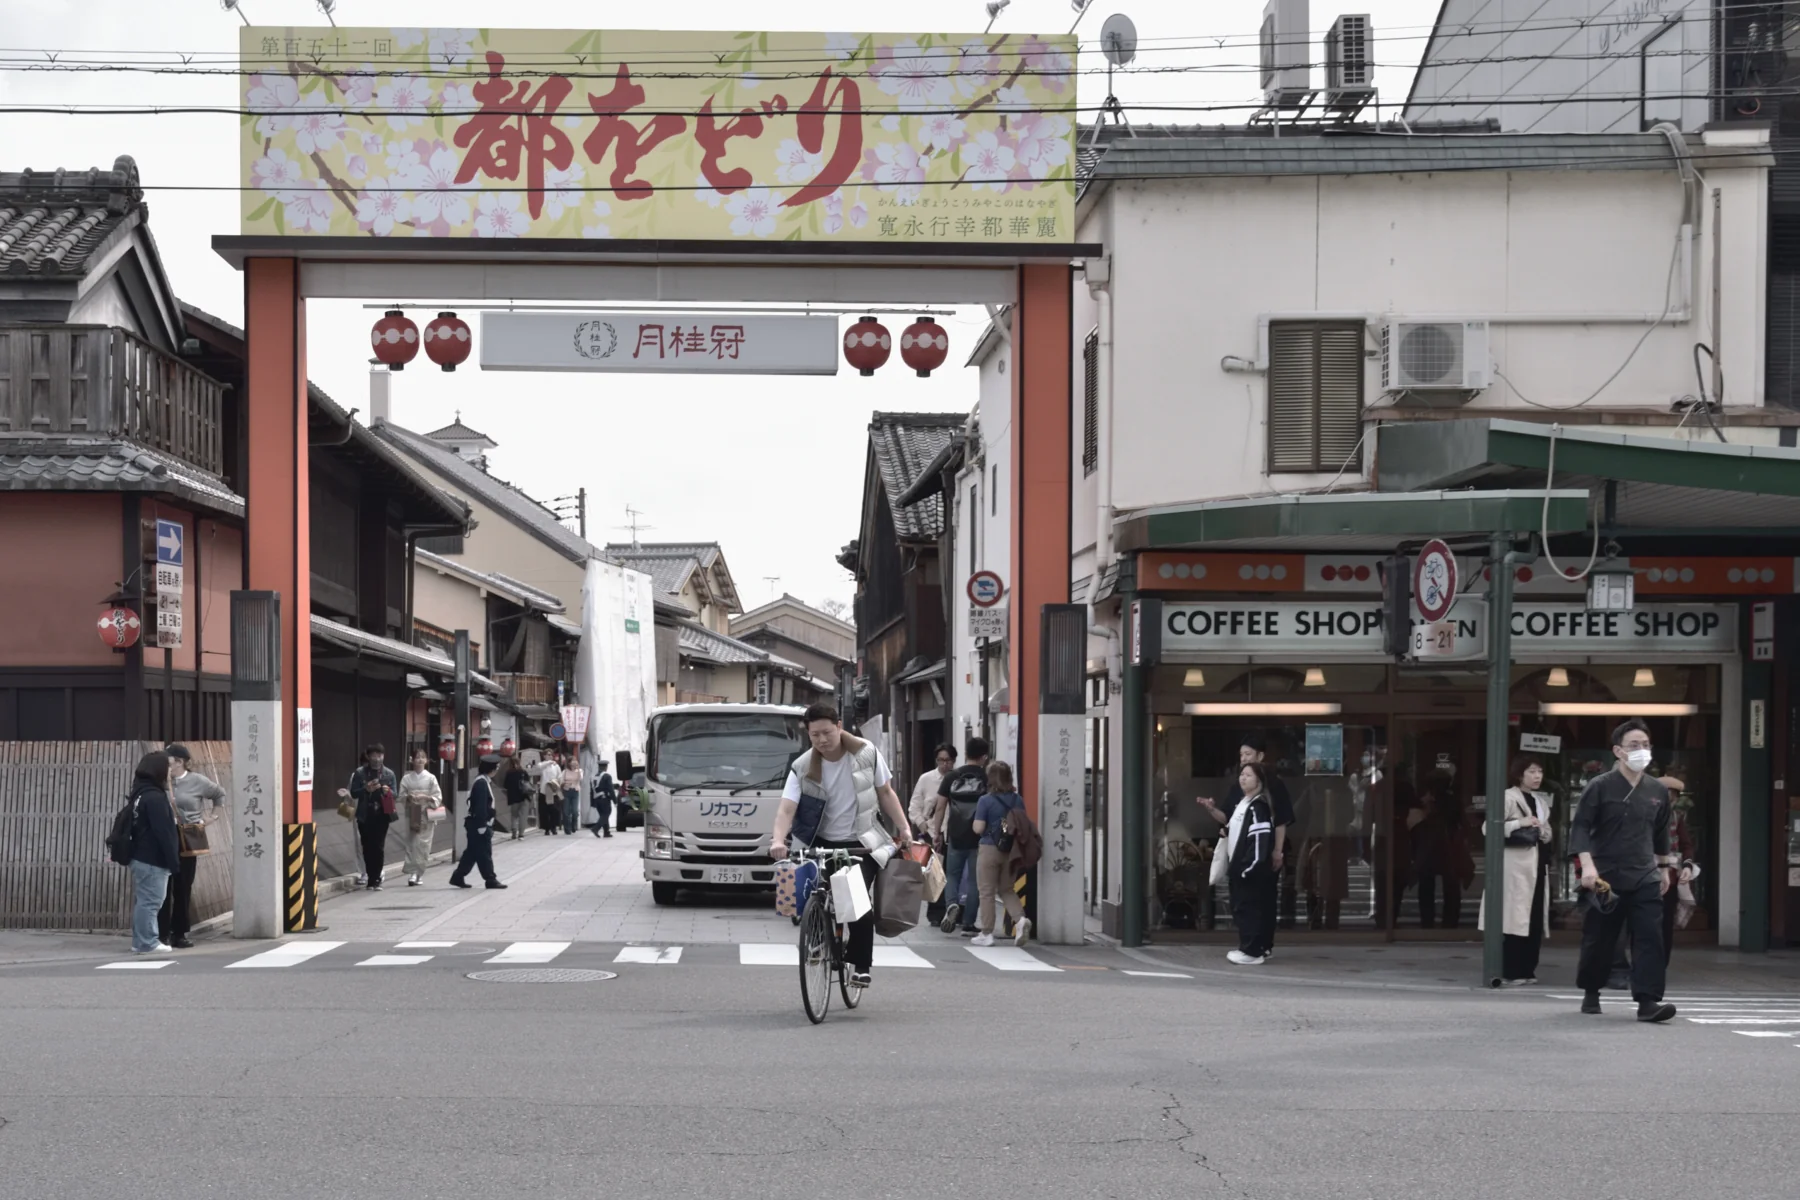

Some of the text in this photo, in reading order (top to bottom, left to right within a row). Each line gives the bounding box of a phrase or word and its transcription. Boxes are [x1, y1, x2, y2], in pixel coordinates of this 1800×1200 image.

[261, 36, 391, 57] 第百五十二回
[453, 50, 863, 221] 都をどり
[632, 323, 746, 360] 月桂冠
[1167, 610, 1279, 636] COFFEE
[1294, 610, 1383, 636] SHOP
[1510, 611, 1720, 637] COFFEE SHOP
[243, 774, 265, 859] 花見小路
[700, 801, 758, 817] リカマン
[1053, 788, 1074, 873] 花見小路
